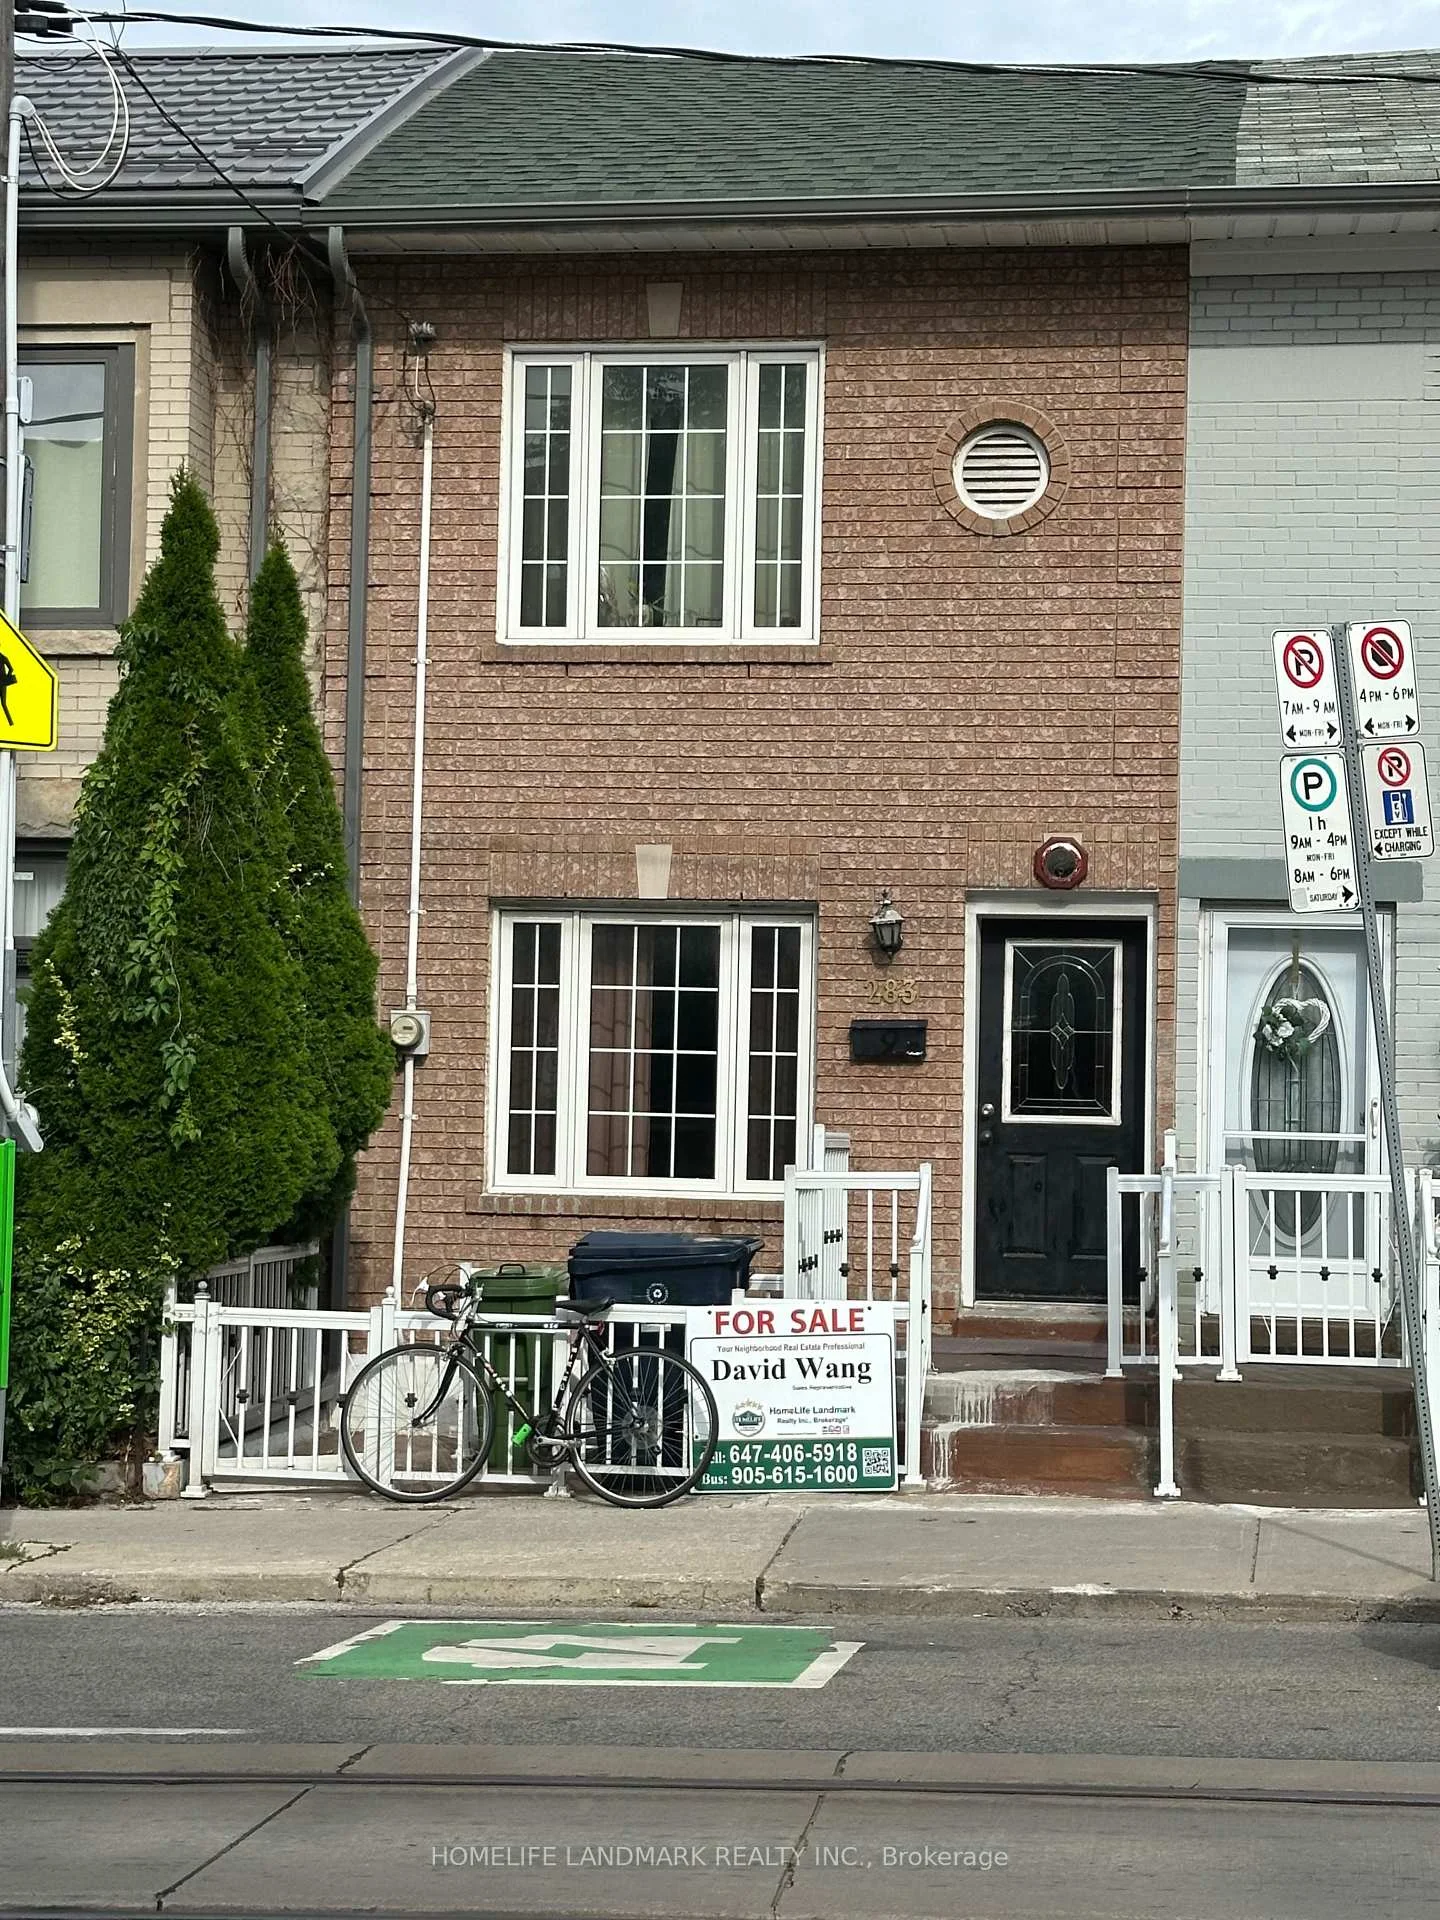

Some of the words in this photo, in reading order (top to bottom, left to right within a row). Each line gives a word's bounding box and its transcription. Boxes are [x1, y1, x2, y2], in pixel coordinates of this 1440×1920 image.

[1303, 772, 1323, 800] P
[1374, 828, 1402, 840] EXCEPT
[1405, 826, 1428, 838] WHILE
[1384, 840, 1422, 853] CHARGING
[1309, 890, 1338, 902] SATURDAY
[864, 979, 919, 1005] 283
[715, 1310, 775, 1336] FOR
[790, 1307, 866, 1334] SALE
[717, 1345, 733, 1353] Your
[801, 1343, 821, 1351] Estate
[823, 1342, 865, 1350] Professional
[711, 1357, 786, 1381] David
[795, 1356, 873, 1385] Wang
[769, 1406, 811, 1415] HomeLife
[813, 1405, 856, 1414] Landmark
[729, 1443, 858, 1464] 647-406-5918
[702, 1473, 728, 1485] Bus:
[731, 1465, 858, 1485] 905-615-1600
